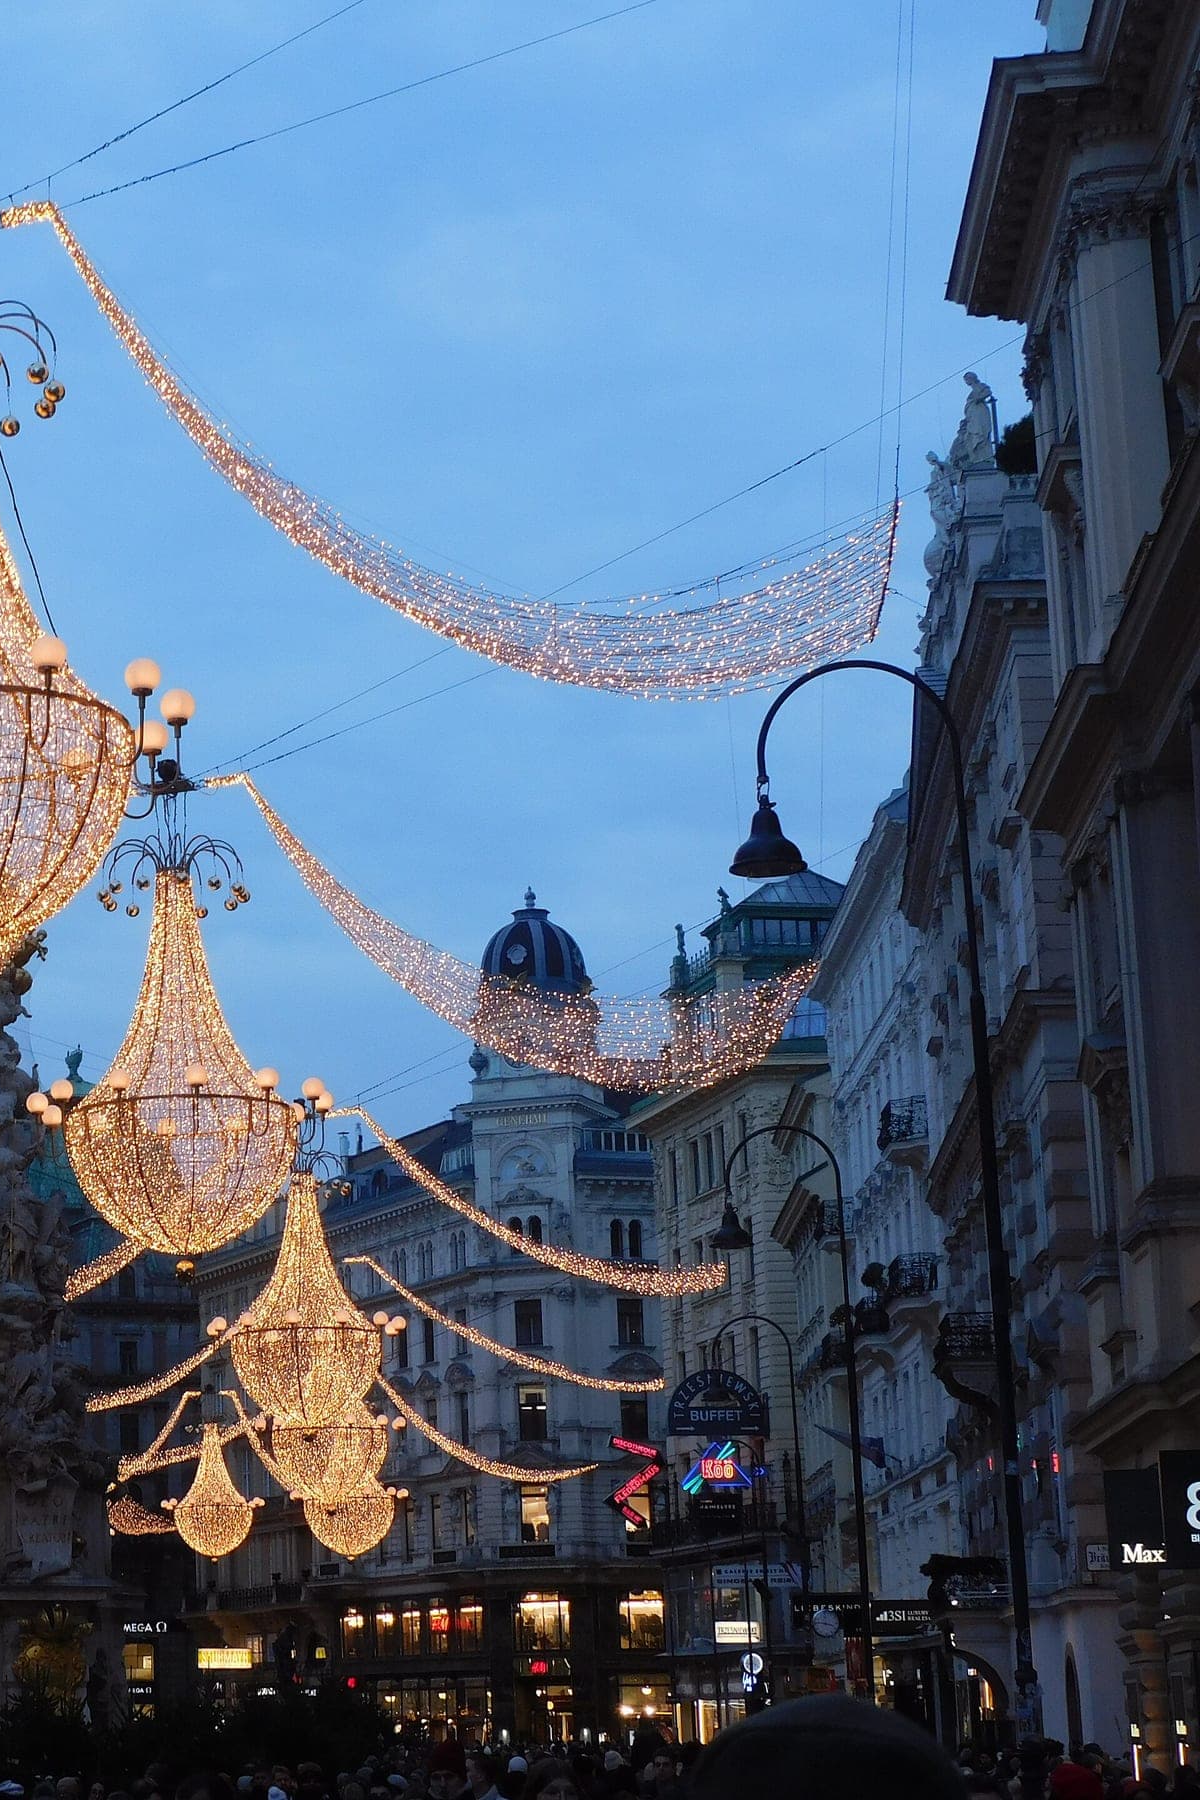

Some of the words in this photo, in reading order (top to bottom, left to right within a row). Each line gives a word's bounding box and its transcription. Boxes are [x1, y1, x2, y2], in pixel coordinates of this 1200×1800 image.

[690, 1409, 742, 1422] BUFFET
[614, 1464, 661, 1504] FLEDERMAUS
[1121, 1542, 1167, 1564] Max
[794, 1603, 862, 1613] LIBESKIND
